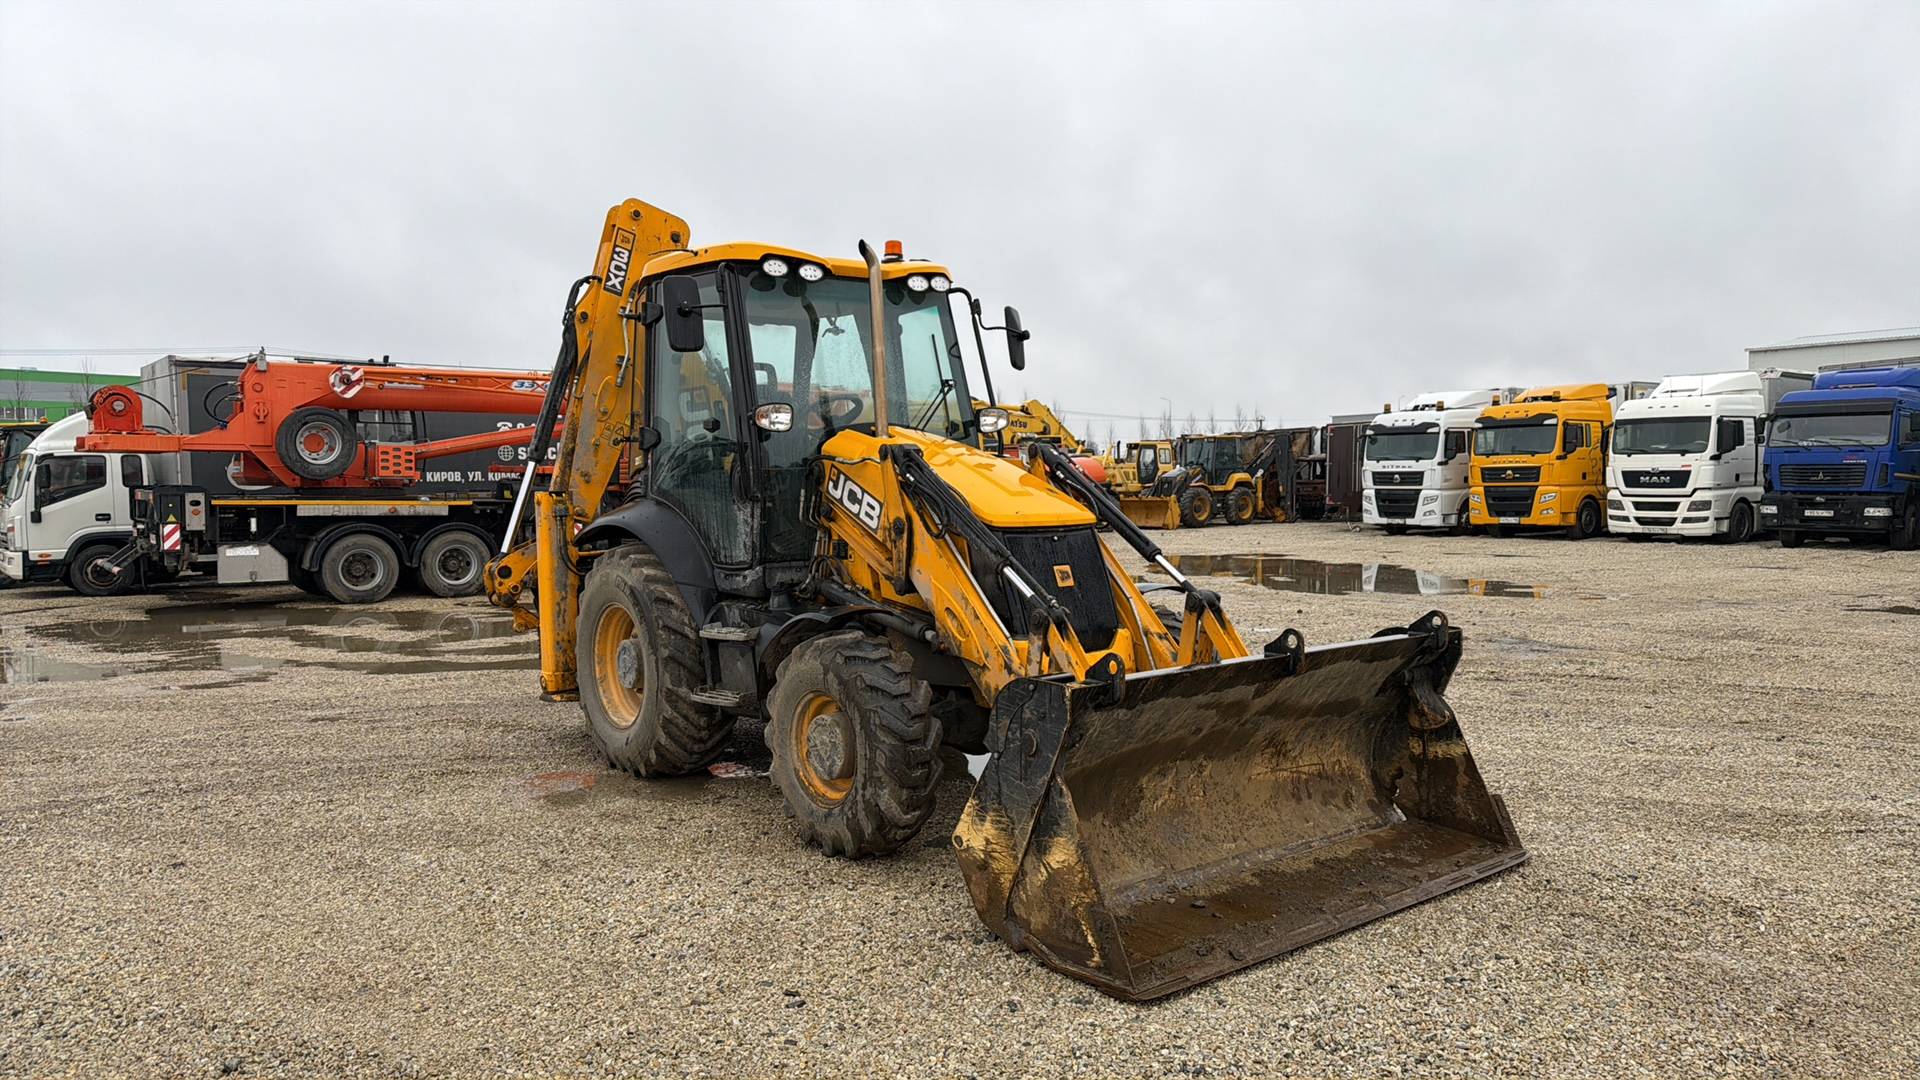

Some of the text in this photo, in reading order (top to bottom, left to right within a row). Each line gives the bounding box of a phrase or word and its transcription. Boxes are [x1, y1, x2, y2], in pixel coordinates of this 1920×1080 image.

[606, 247, 630, 290] 3CX
[426, 471, 465, 484] КИРОВ,
[467, 471, 485, 482] УЛ.
[827, 473, 881, 530] JCB
